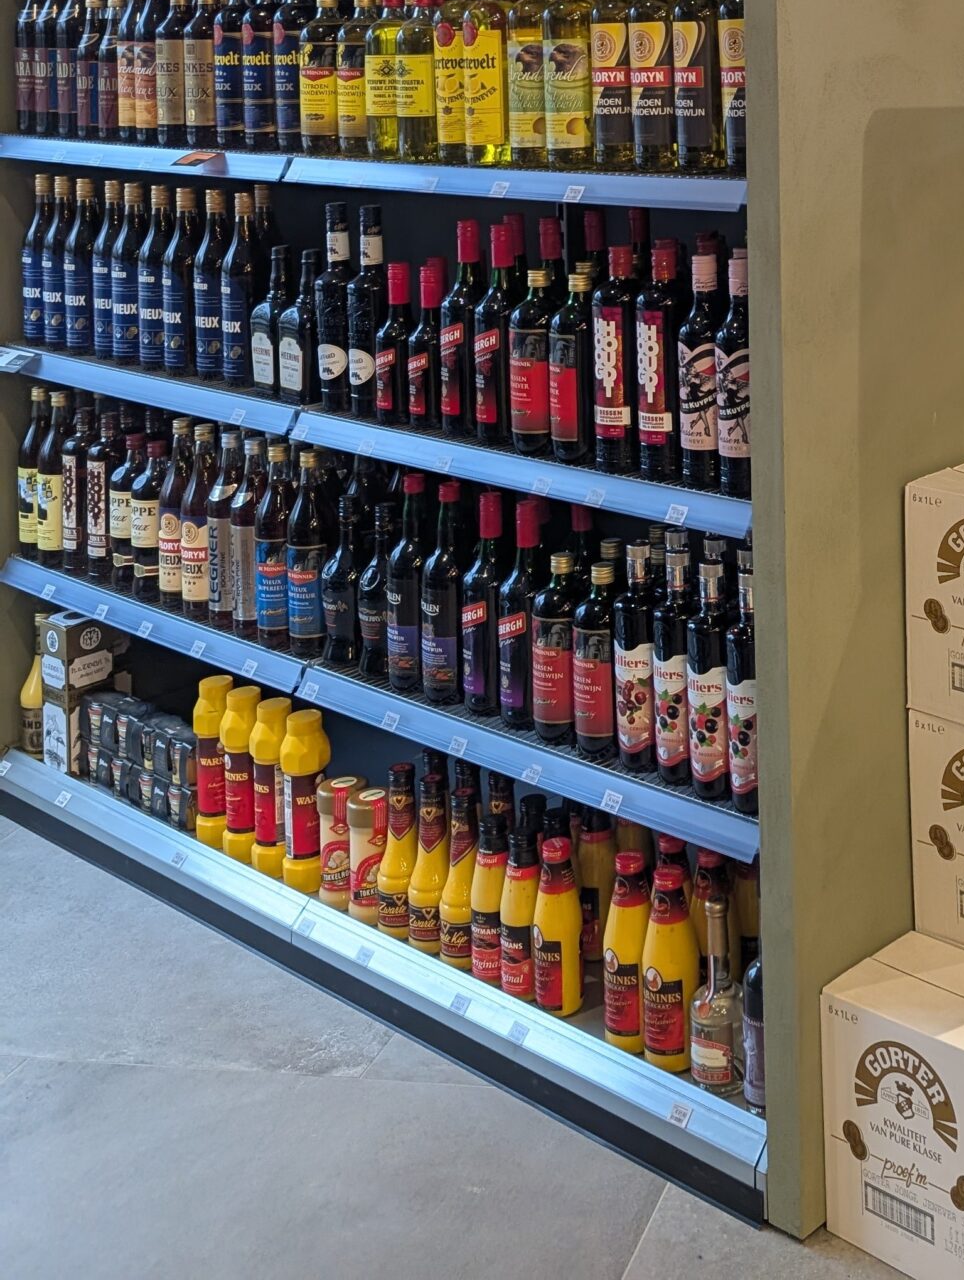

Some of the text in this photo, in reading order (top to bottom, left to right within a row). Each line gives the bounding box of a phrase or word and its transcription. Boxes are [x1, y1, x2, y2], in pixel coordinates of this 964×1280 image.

[471, 86, 497, 105] JENEVER
[113, 303, 138, 314] VIEUX
[140, 308, 164, 320] VIEUX
[163, 312, 181, 324] IEUX
[195, 316, 219, 328] VIEUX
[222, 321, 241, 333] IEUX
[183, 563, 203, 574] IEUX
[498, 619, 523, 634] BERGH
[864, 1046, 945, 1106] GORTER
[883, 1117, 927, 1145] KWALITEIT
[869, 1121, 943, 1164] VAN PURE KLASSE
[881, 1158, 928, 1188] proef'm
